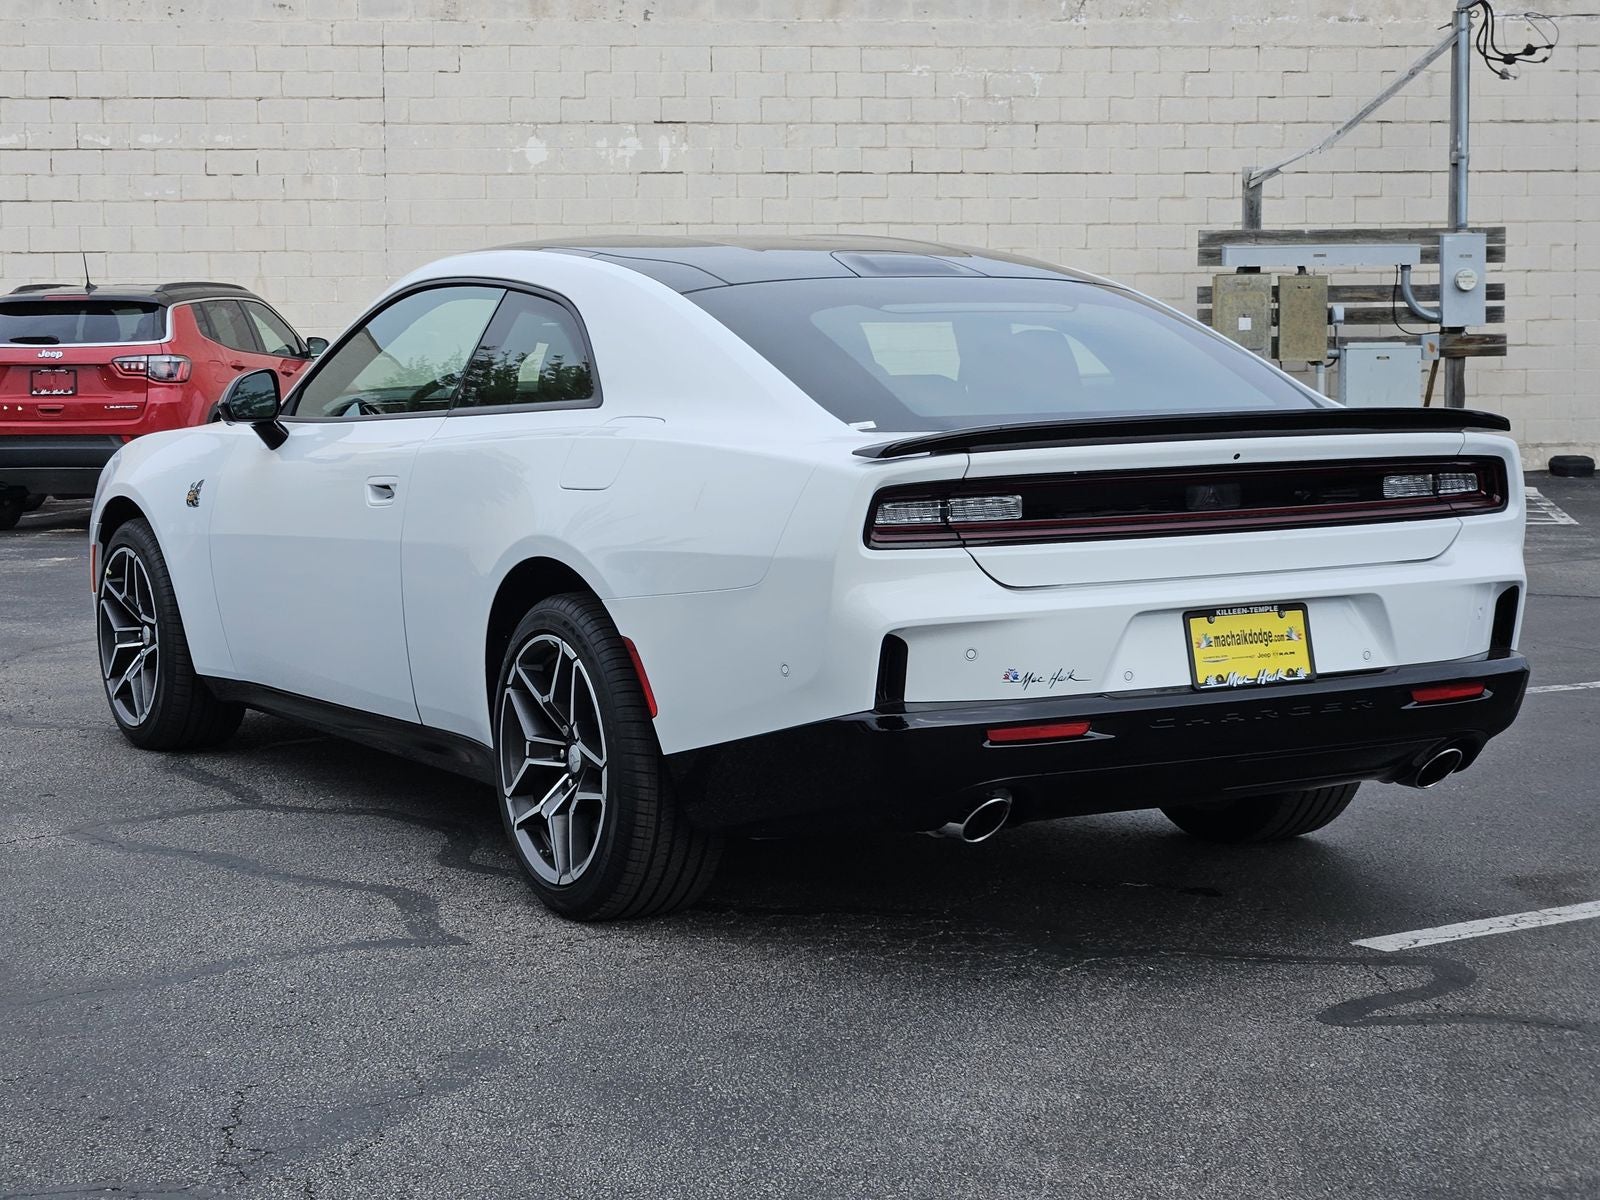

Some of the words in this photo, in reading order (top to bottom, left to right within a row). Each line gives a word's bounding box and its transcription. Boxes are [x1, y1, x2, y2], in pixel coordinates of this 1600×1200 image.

[37, 349, 63, 359] Jeep
[1215, 605, 1279, 616] KILLEEN-TEMPLE
[1214, 628, 1285, 647] machaikdodge.com
[1257, 651, 1272, 659] Jeep
[1020, 672, 1046, 691] Mac
[1047, 668, 1085, 689] Haik
